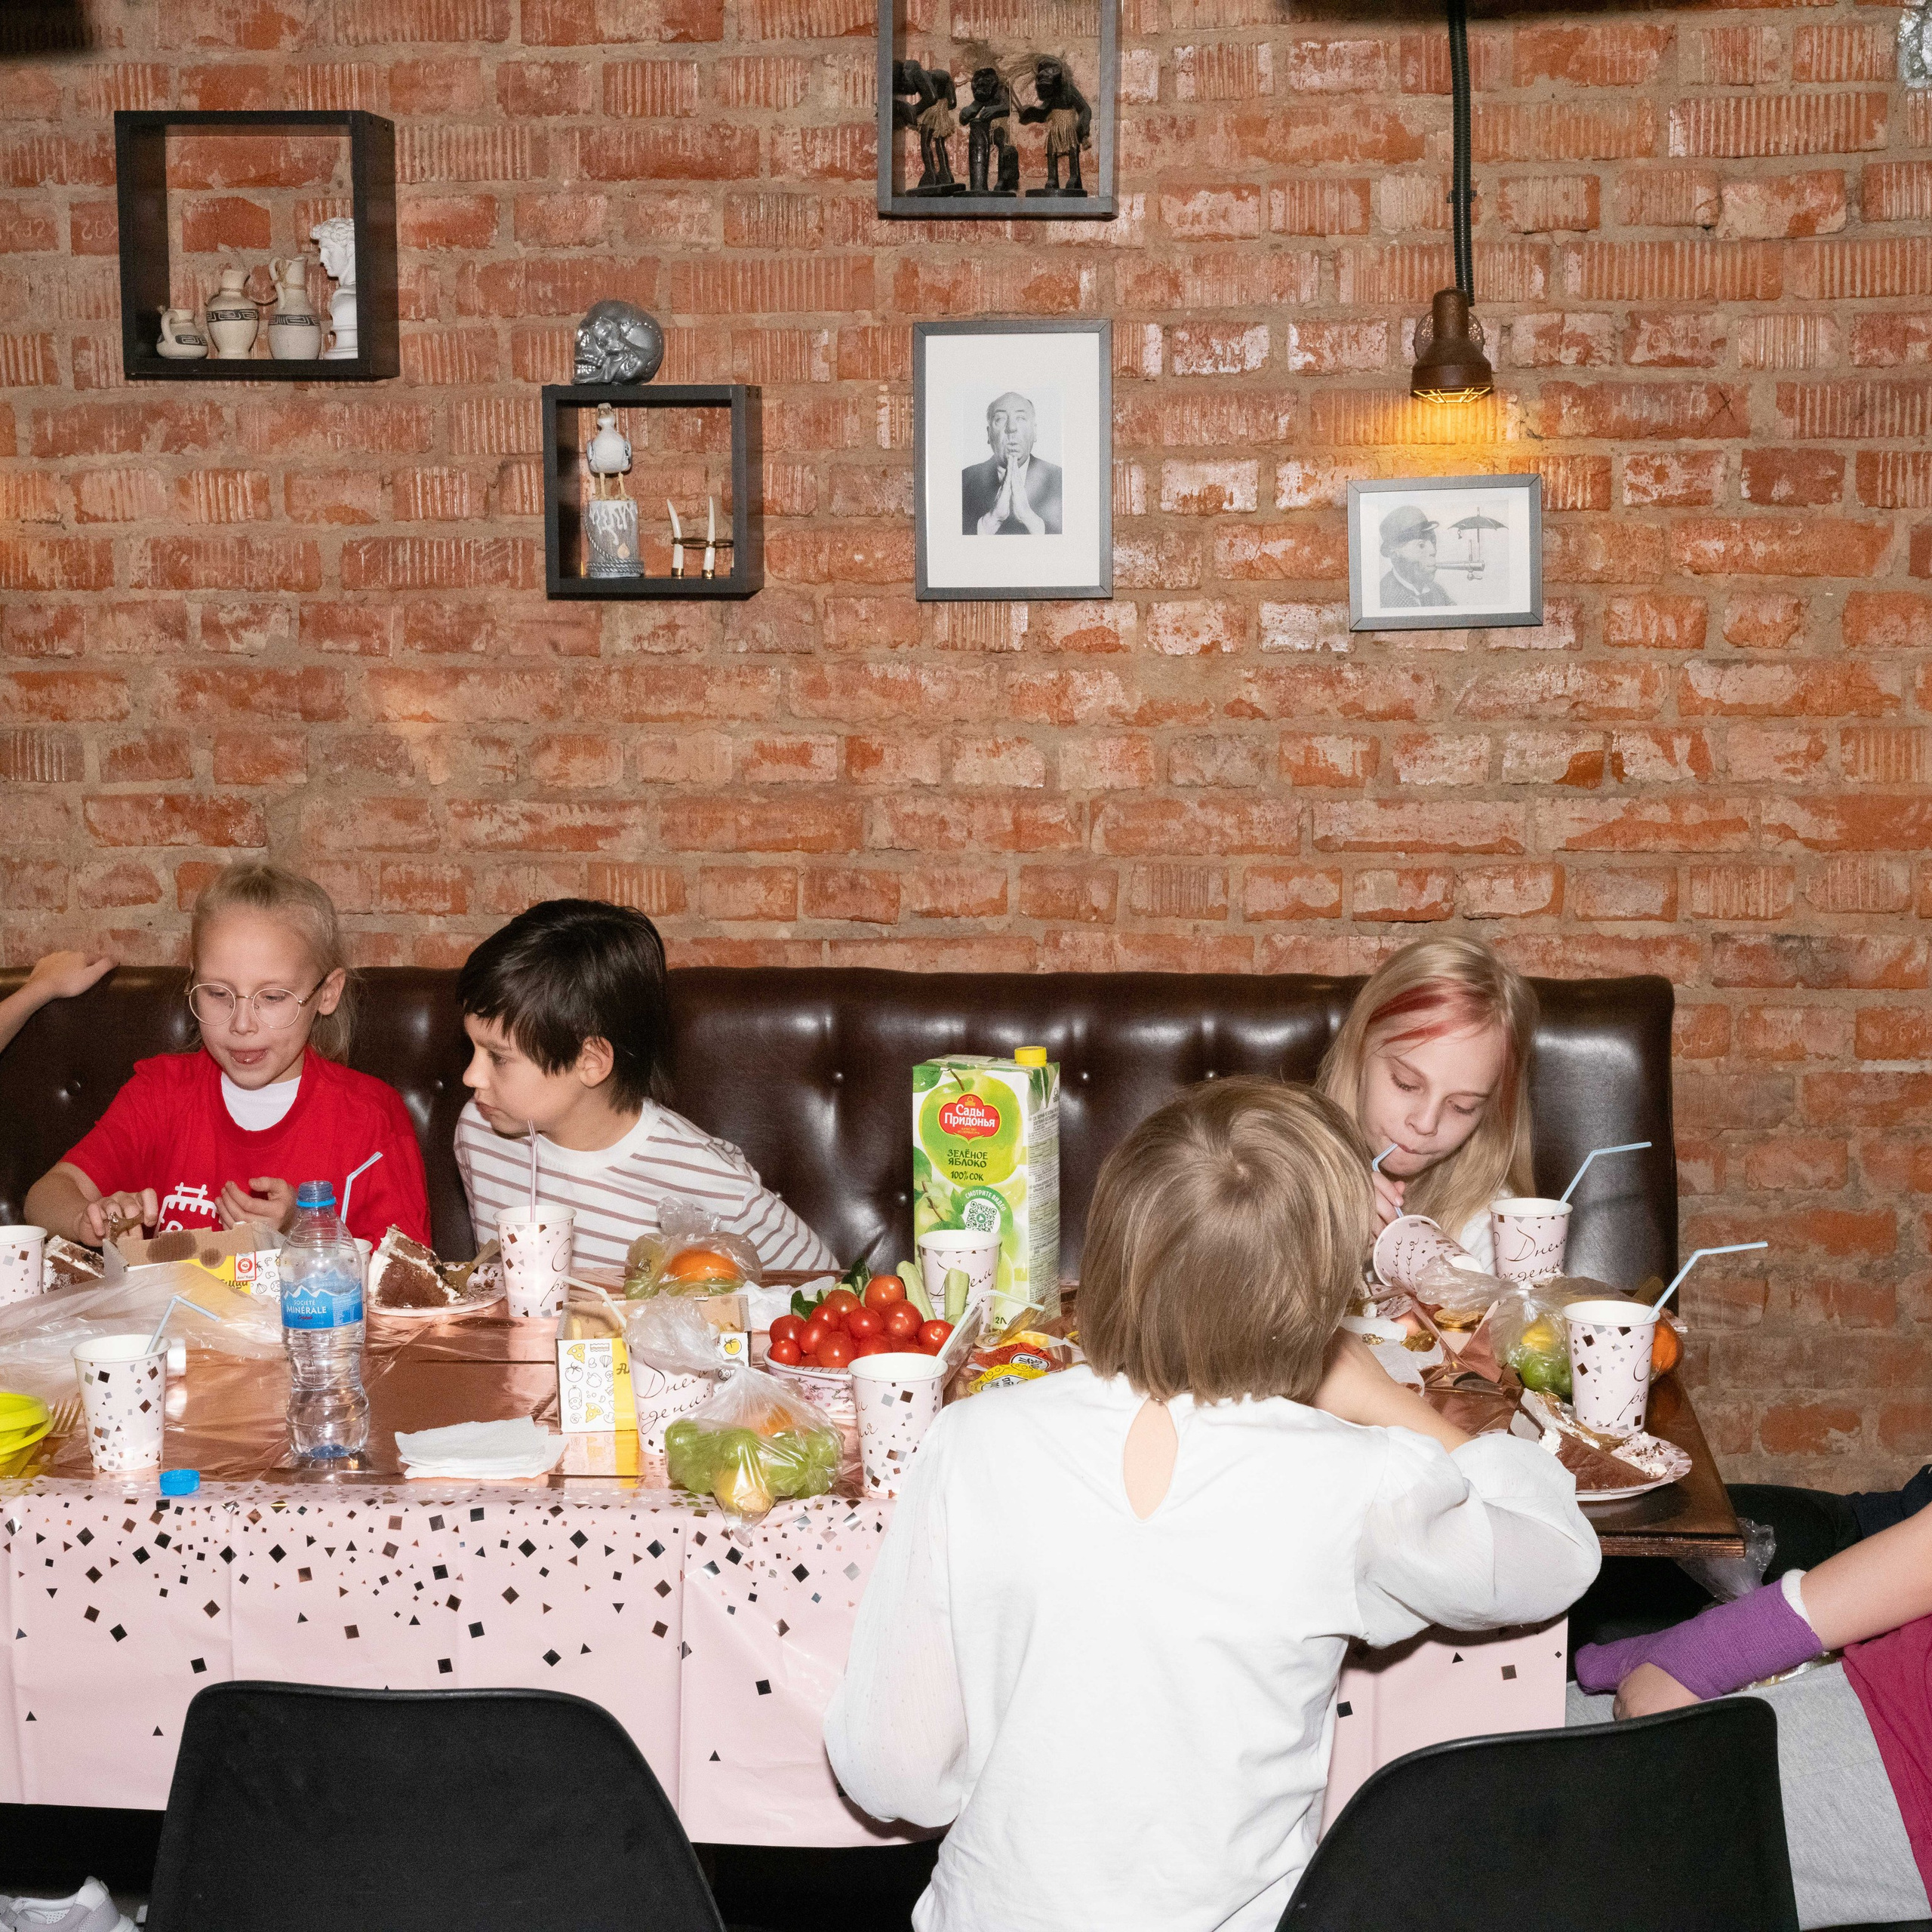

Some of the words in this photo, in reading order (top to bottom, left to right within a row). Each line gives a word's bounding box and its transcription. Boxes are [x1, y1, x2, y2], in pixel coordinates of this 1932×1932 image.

[955, 1104, 985, 1117] Сады
[944, 1112, 995, 1128] Придонья
[947, 1149, 989, 1160] ЗЕЛЁНОЕ
[948, 1158, 987, 1168] ЯБЛОКО
[969, 1173, 984, 1181] СОК
[964, 1189, 992, 1199] СМОТРИТЕ
[992, 1194, 1007, 1212] ВИДЕО
[286, 1306, 328, 1314] MINÉRALE
